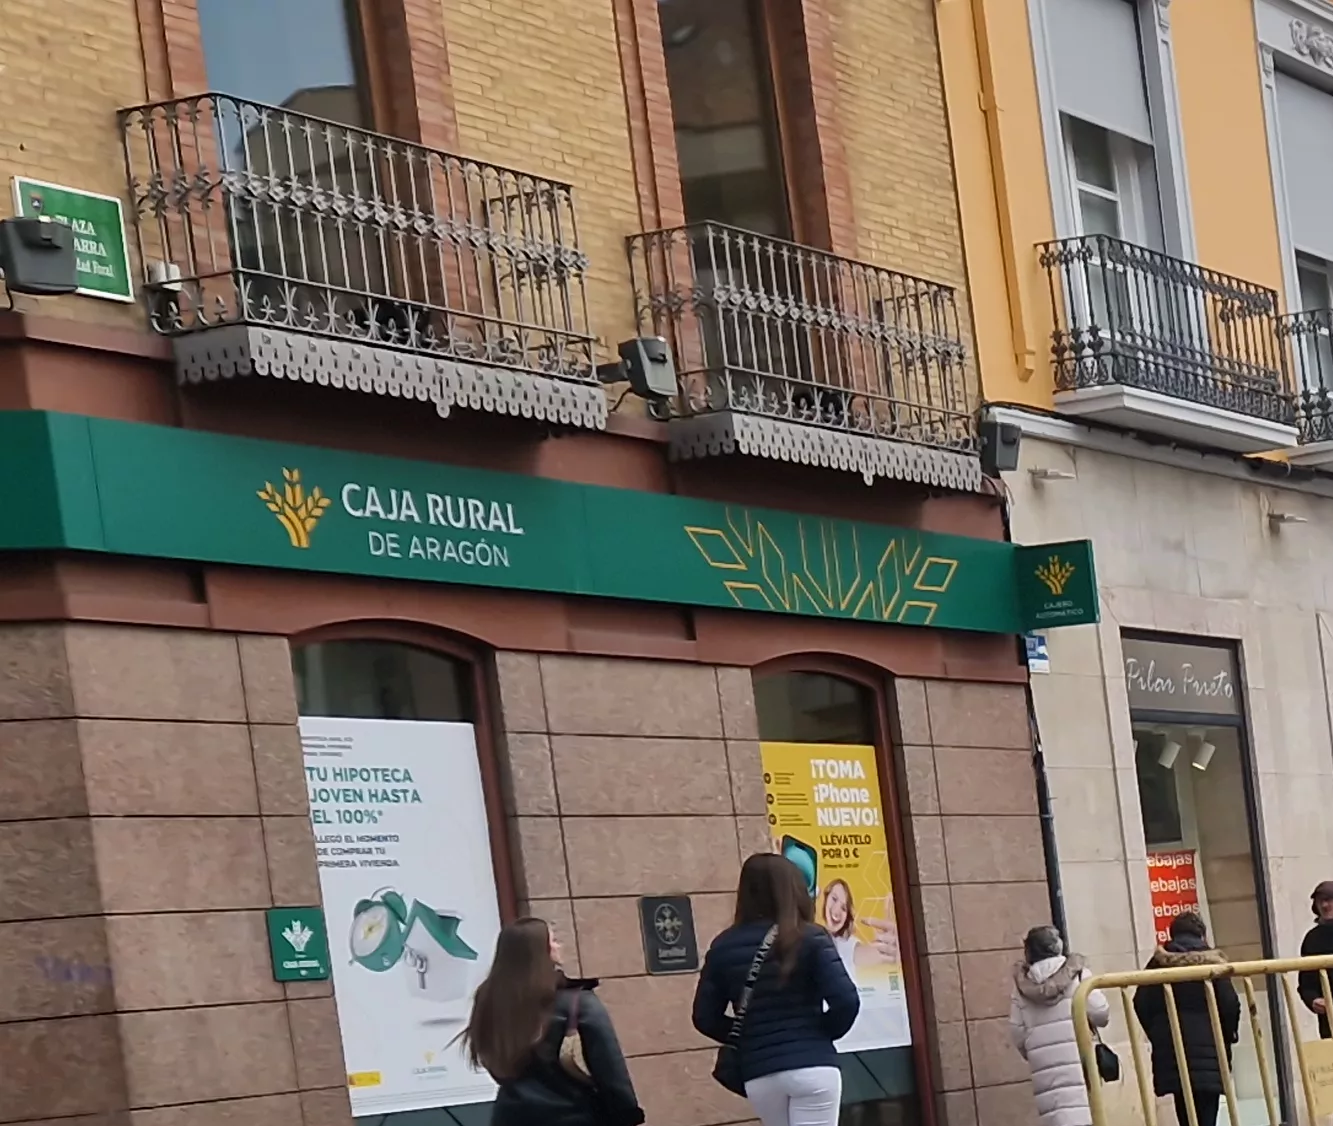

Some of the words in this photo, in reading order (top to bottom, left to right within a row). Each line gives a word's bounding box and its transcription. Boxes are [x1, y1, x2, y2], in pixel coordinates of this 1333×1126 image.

[73, 238, 108, 257] ARRA
[341, 482, 422, 524] CAJA
[426, 492, 526, 535] RURAL
[368, 531, 402, 558] DE
[408, 535, 511, 567] ARAGÓN
[1126, 658, 1176, 694] Pilar
[1181, 663, 1234, 698] Prieto
[305, 767, 328, 782] TU
[332, 767, 414, 783] HIPOTECA
[310, 788, 364, 803] JOVEN
[367, 788, 422, 803] HASTA
[813, 783, 870, 803] iPhone
[312, 809, 333, 824] EL
[817, 807, 879, 826] NUEVO!
[821, 847, 842, 859] POR
[843, 847, 850, 859] 0
[1146, 852, 1193, 870] ebajas
[1150, 876, 1197, 894] ebajas
